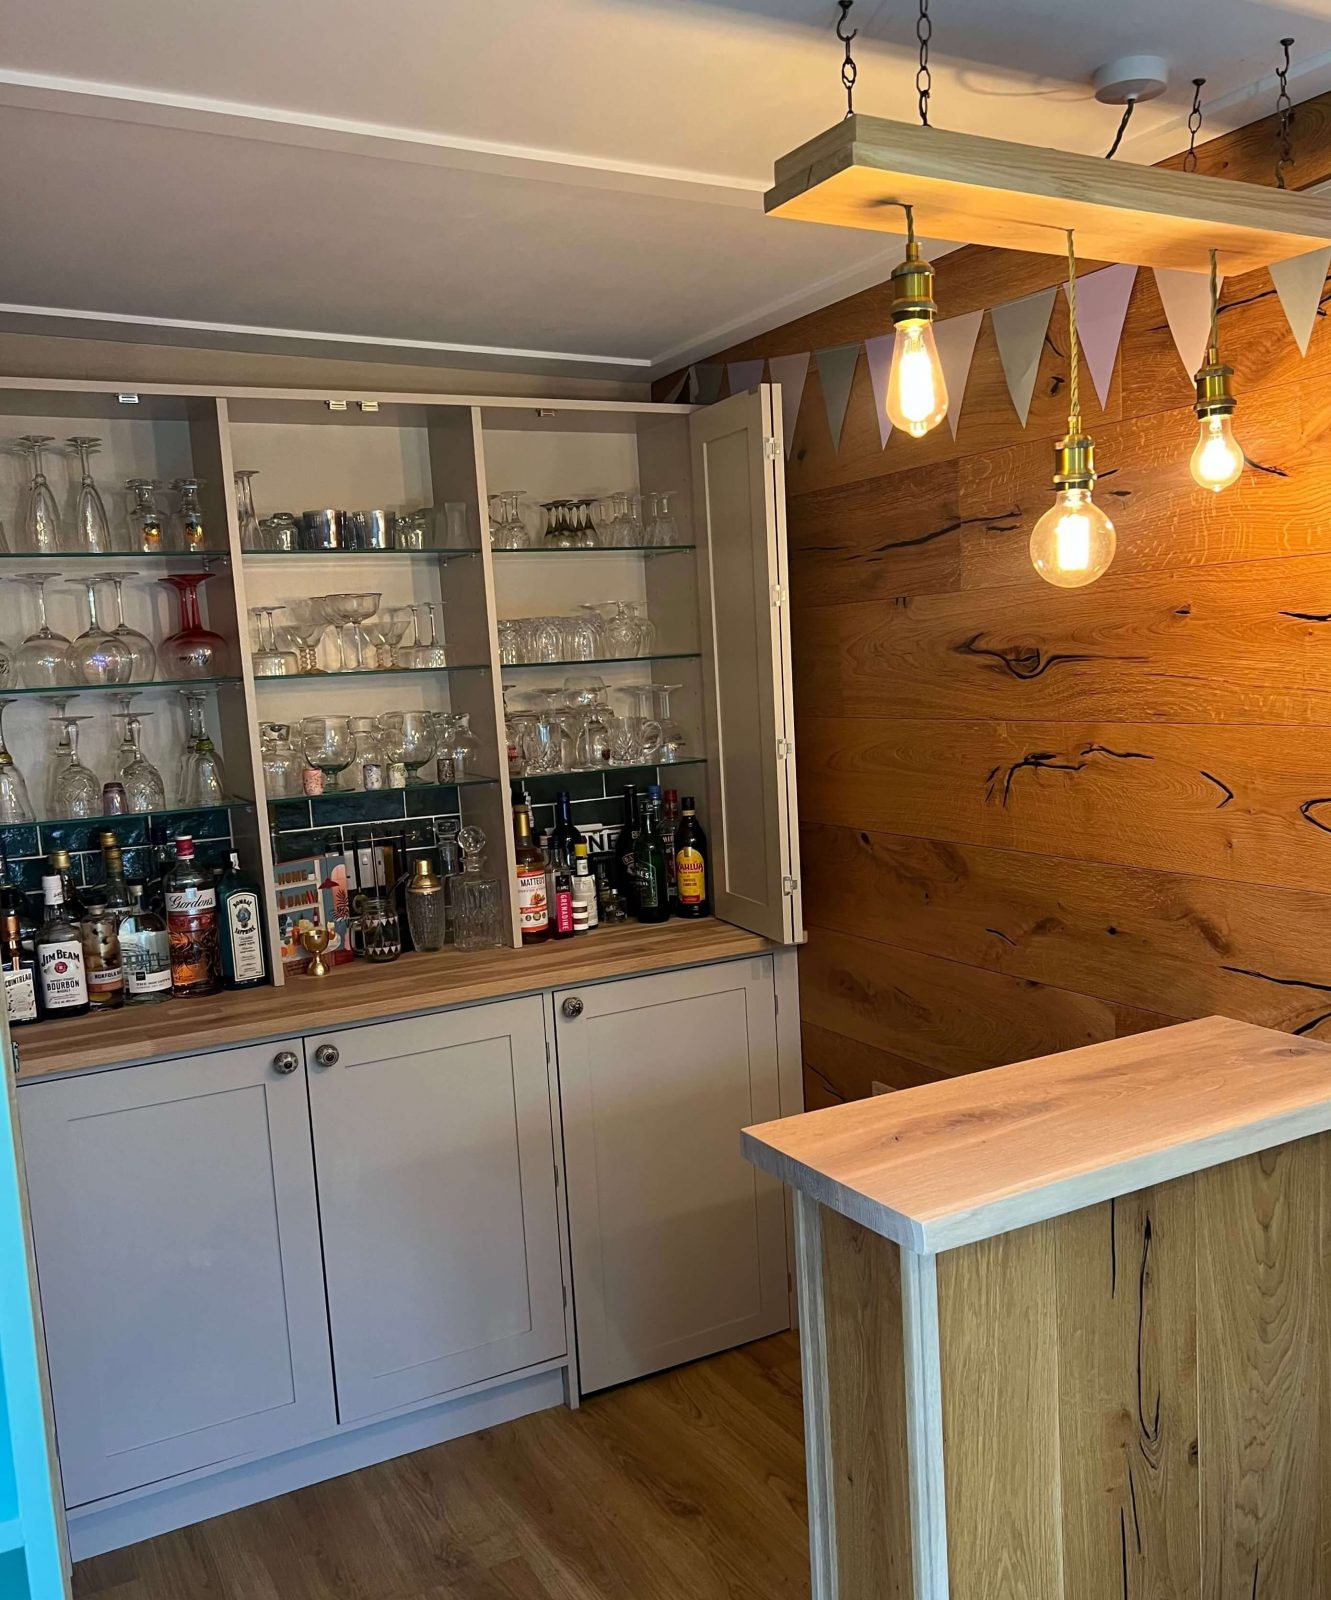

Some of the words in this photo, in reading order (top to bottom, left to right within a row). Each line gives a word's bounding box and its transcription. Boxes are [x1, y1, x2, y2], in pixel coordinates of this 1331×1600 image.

[278, 869, 308, 886] HOME
[560, 894, 569, 930] GRENADINE
[41, 953, 56, 967] JIM
[56, 949, 80, 963] BEAM
[5, 973, 32, 988] COINTREAU
[47, 979, 80, 991] BOURBON
